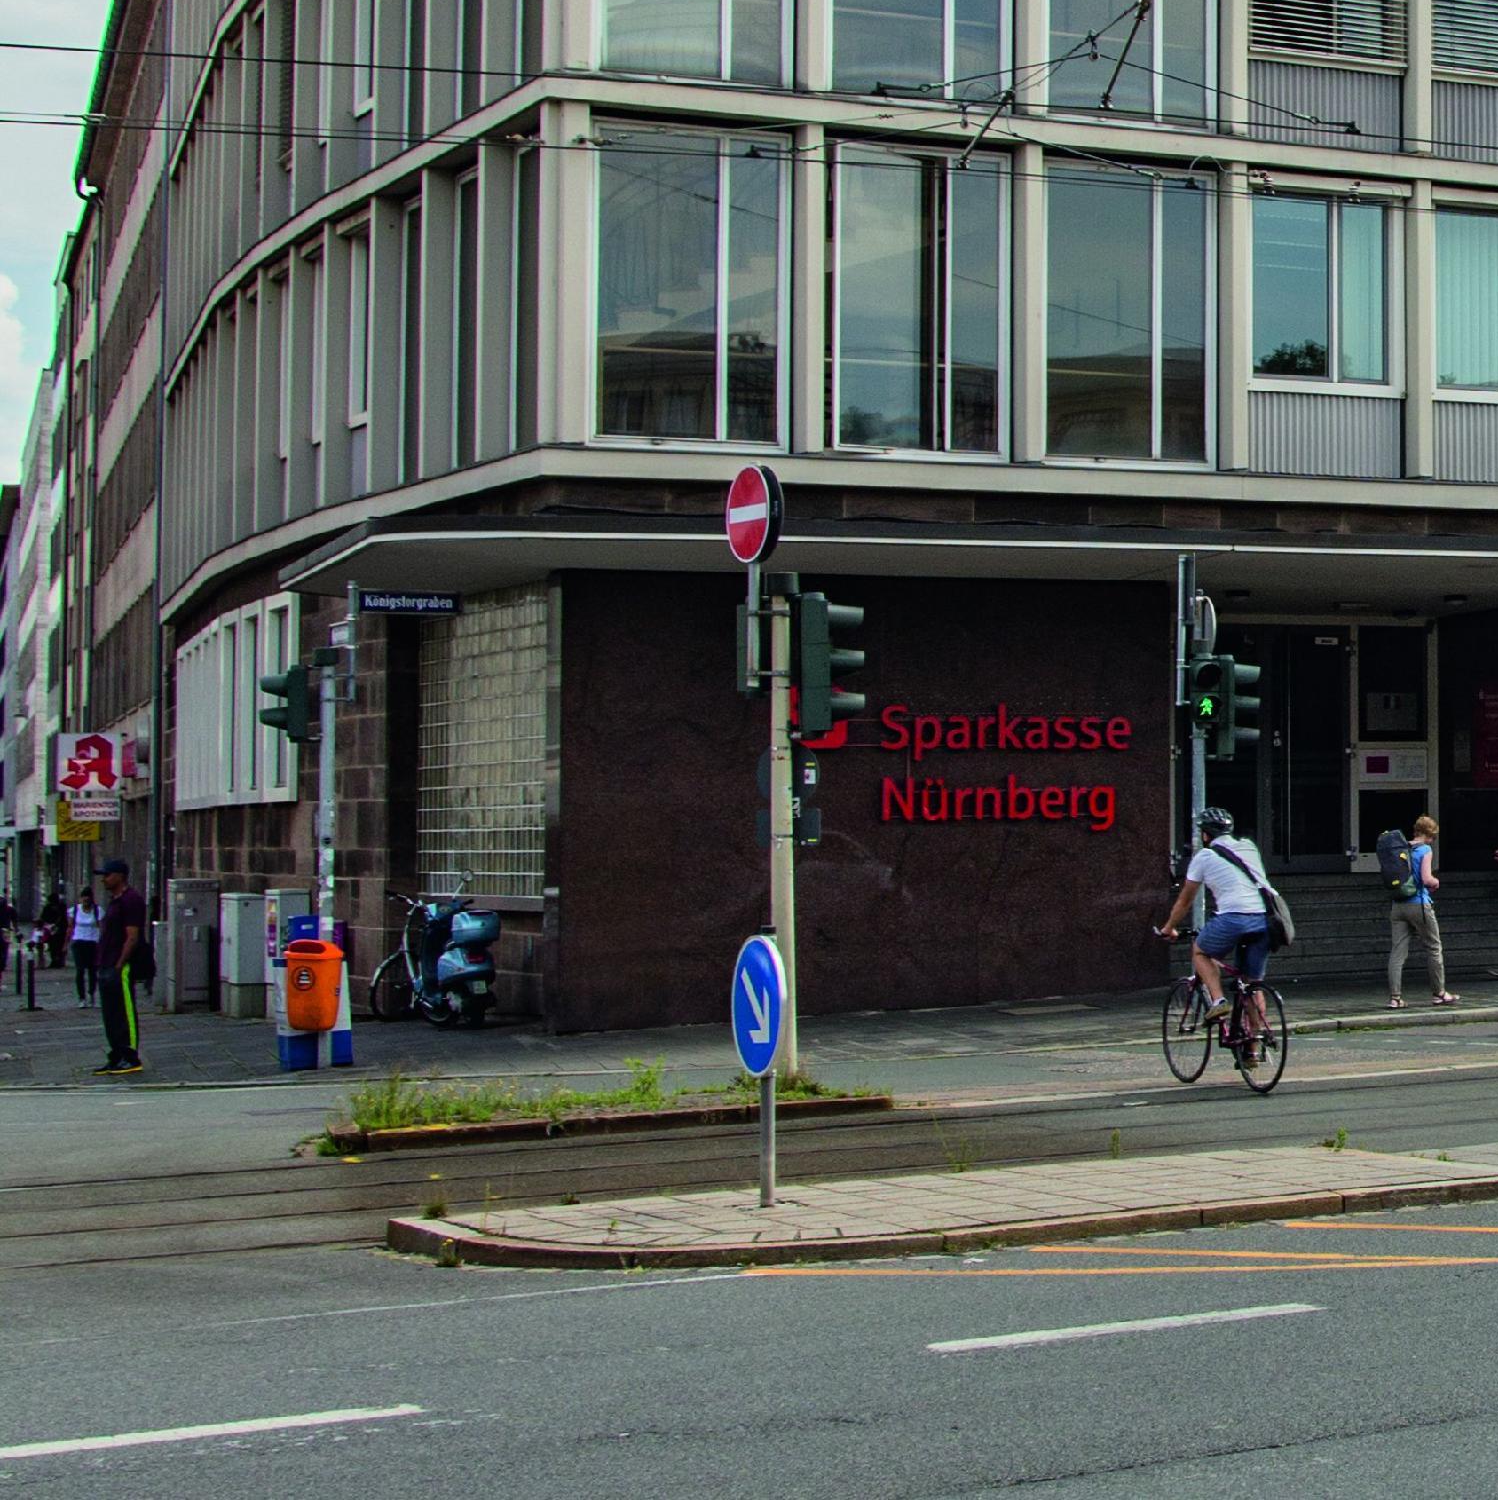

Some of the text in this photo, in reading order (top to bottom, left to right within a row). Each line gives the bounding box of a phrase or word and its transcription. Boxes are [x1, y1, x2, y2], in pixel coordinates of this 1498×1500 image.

[364, 594, 454, 610] Königstorgraben
[880, 702, 1132, 761] Sparkasse
[881, 773, 1116, 831] Nürnberg
